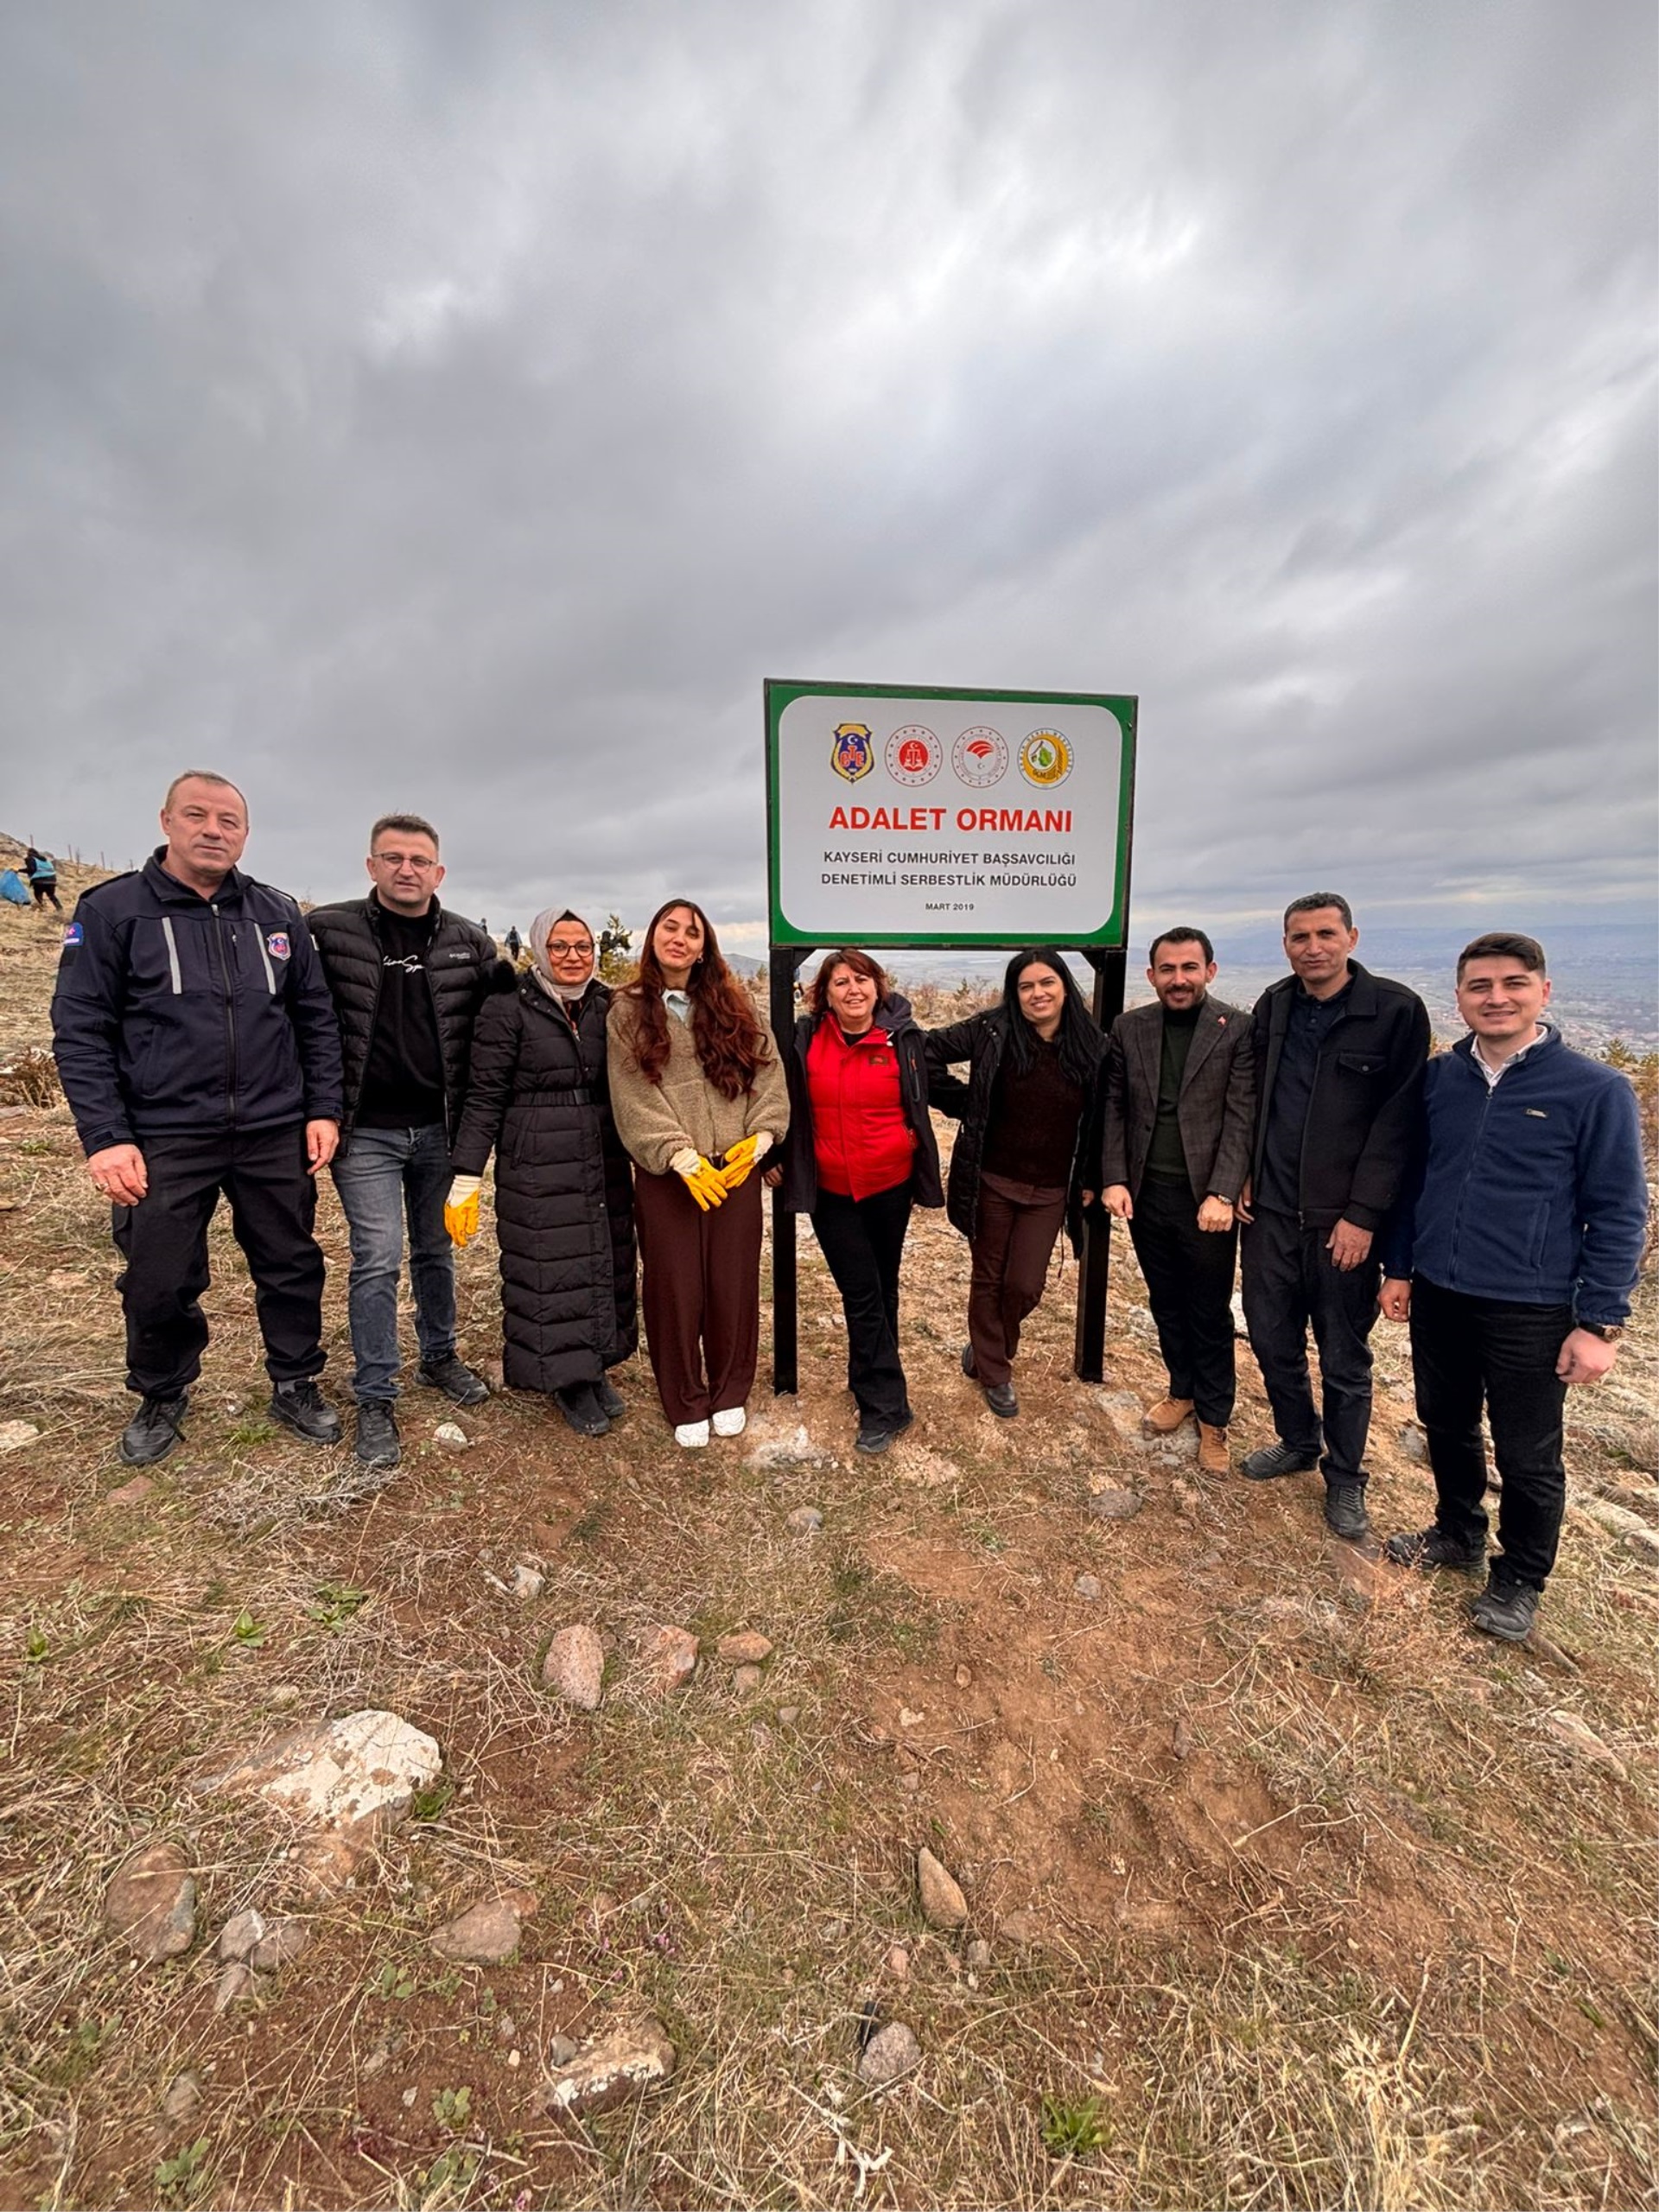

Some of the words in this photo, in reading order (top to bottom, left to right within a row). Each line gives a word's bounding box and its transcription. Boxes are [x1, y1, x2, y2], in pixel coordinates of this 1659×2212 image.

[829, 806, 947, 830] ADALET
[956, 808, 1073, 833] ORMANI
[823, 850, 882, 863] KAYSERİ
[887, 851, 979, 864] CUMHURİYET
[983, 852, 1075, 867] BAŞSAVCILIĞI
[821, 871, 896, 885] DENETİMLİ
[900, 873, 985, 886] SERBESTLİK
[989, 873, 1077, 887] MÜDÜRLÜĞÜ
